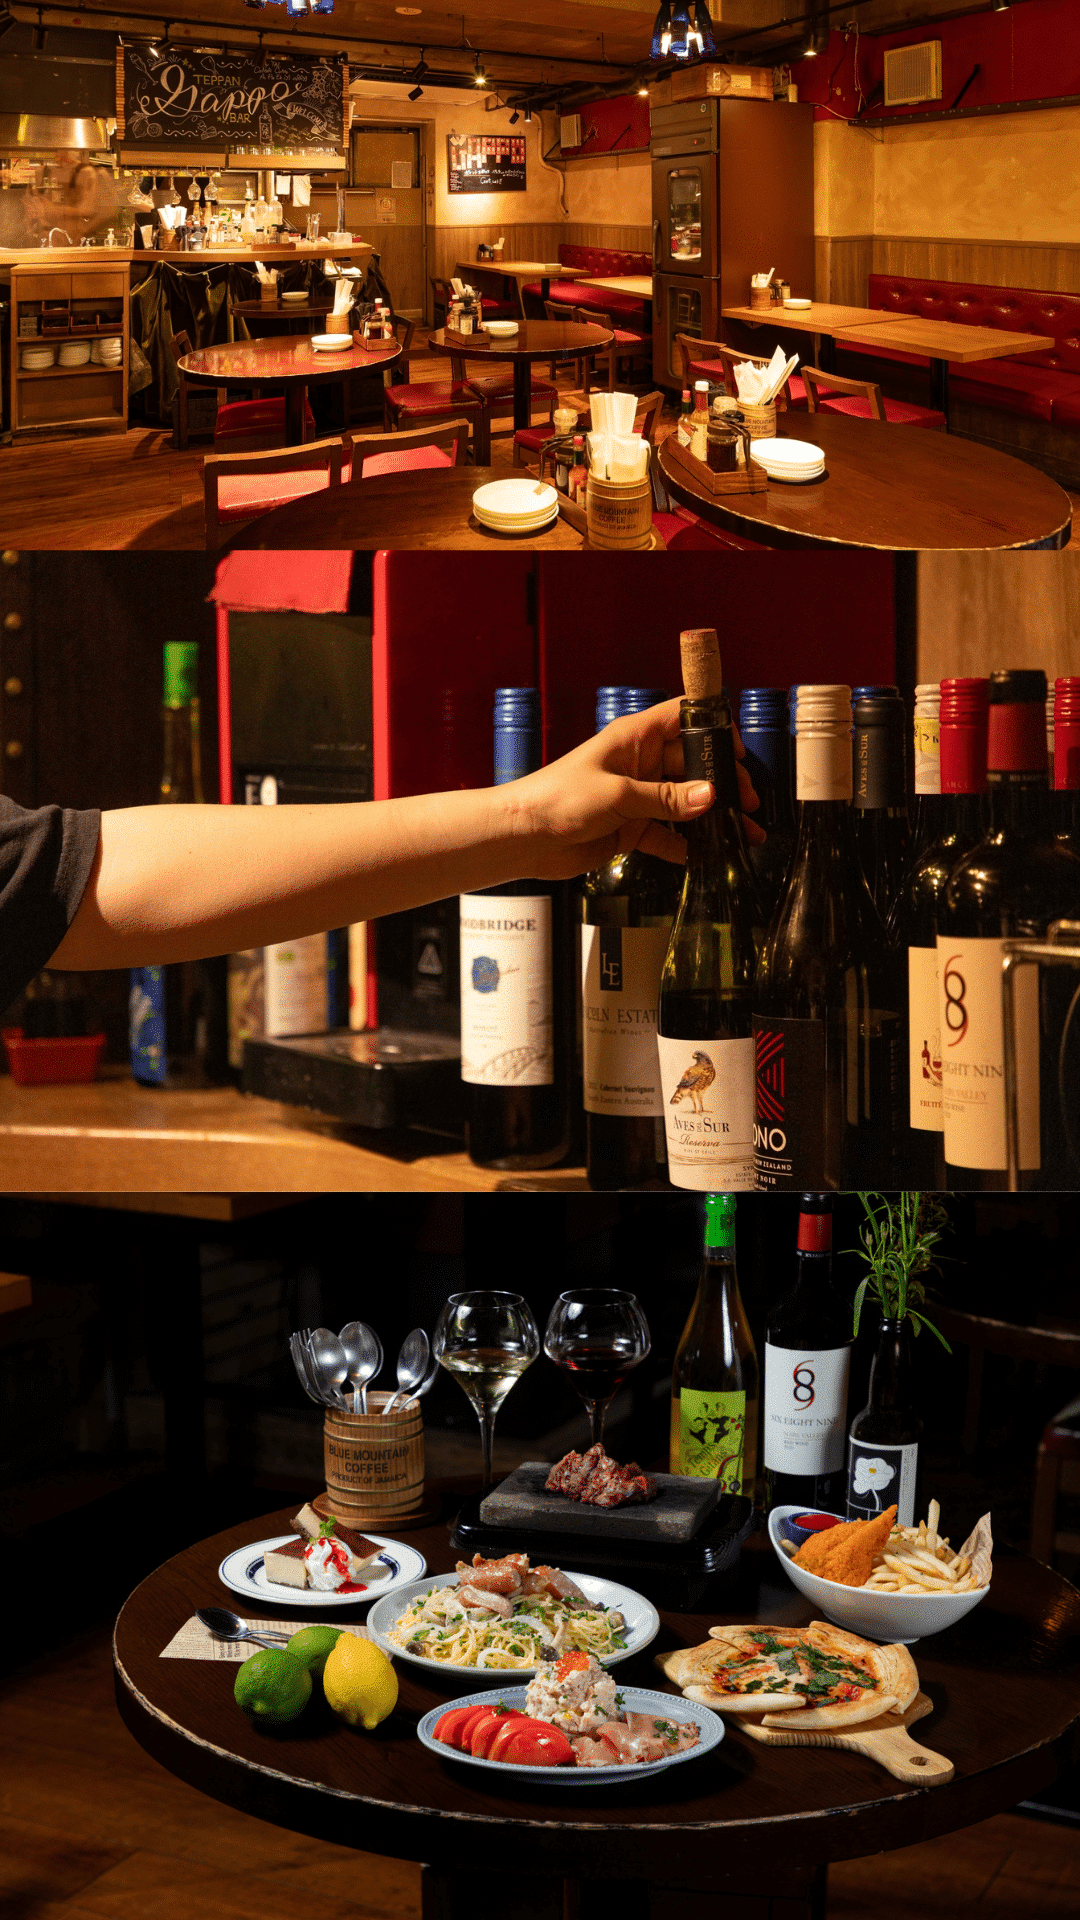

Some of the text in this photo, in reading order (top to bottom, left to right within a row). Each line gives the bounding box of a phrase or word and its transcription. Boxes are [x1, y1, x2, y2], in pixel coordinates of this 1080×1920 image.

[193, 74, 241, 87] TEPPAN
[229, 112, 252, 124] BAR
[292, 104, 325, 128] WELCOME
[604, 506, 640, 515] MOUNTAIN
[598, 514, 626, 523] COFFEE
[679, 1134, 720, 1147] Reserva
[762, 1160, 792, 1171] ZEALAND
[784, 1417, 813, 1427] EIGHT
[329, 1444, 409, 1461] BLUE MOUNTAIN
[345, 1462, 389, 1474] COFFEE
[331, 1471, 407, 1484] PRODUCT OF JAMAICA
